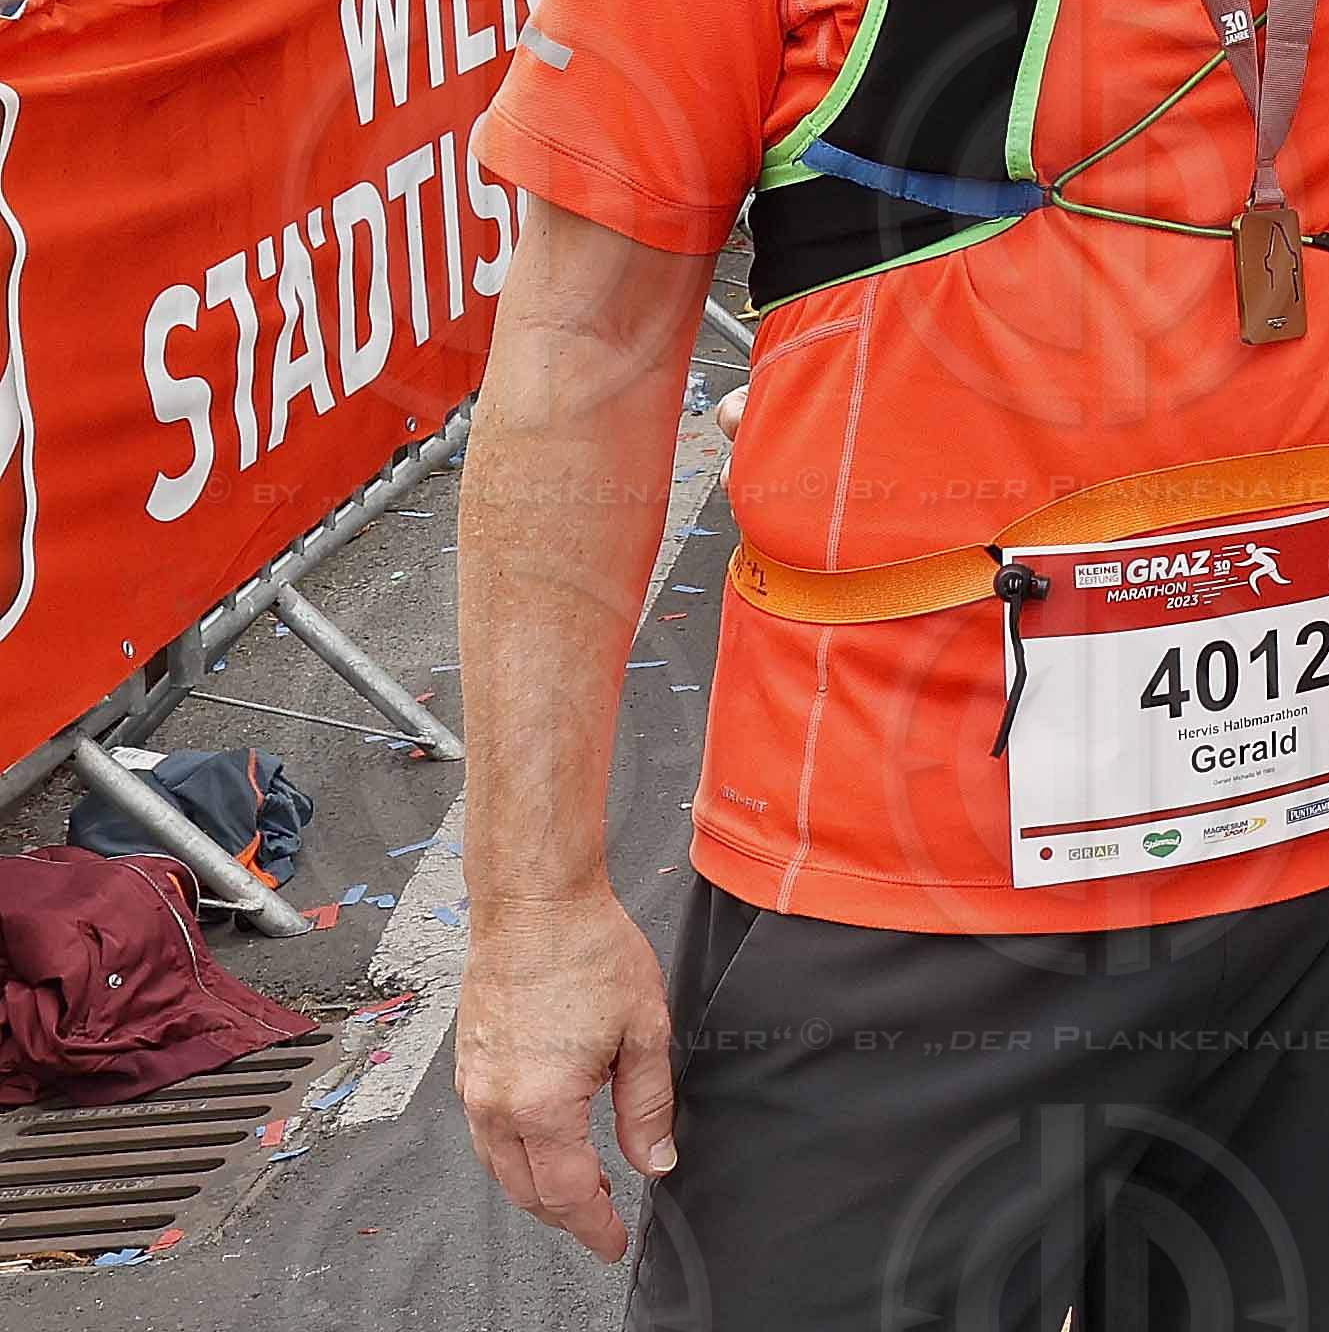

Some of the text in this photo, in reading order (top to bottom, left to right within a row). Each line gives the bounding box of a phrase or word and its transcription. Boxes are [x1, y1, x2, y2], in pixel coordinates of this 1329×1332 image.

[1221, 10, 1248, 32] 30
[1224, 29, 1251, 46] JAHRE
[1078, 565, 1119, 577] KLEINE
[1126, 550, 1231, 584] GRAZ 30
[1078, 575, 1120, 586] ZEITUNG
[1106, 580, 1188, 603] MARATHON
[1166, 594, 1200, 610] 2023
[1178, 705, 1309, 741] Hervis Halbmarathon
[1191, 725, 1297, 774] Gerald
[1203, 818, 1249, 837] MAGNESIUM
[1223, 827, 1248, 838] SPORT
[1069, 844, 1119, 860] GRAZ
